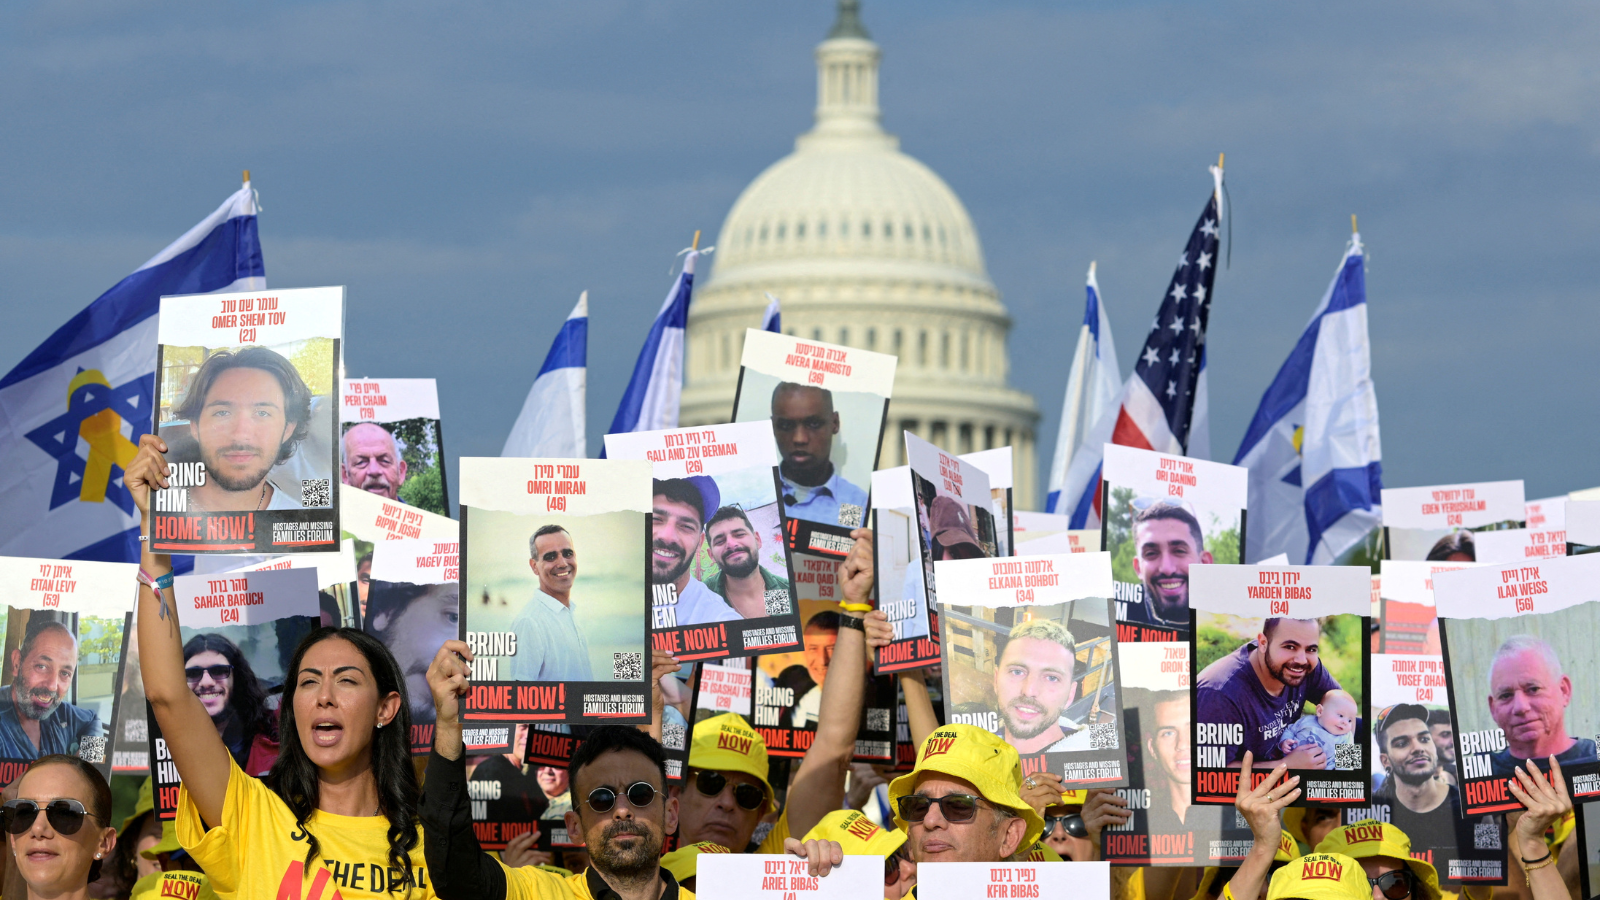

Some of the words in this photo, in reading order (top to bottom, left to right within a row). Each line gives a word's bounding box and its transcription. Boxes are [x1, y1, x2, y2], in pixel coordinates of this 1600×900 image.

[220, 300, 236, 314] טוב
[239, 299, 254, 312] שם
[256, 297, 278, 311] עומר
[212, 315, 237, 329] OMER
[240, 312, 265, 327] SHEM
[267, 311, 286, 326] TOV
[239, 327, 256, 343] (21)
[785, 354, 810, 369] AVERA
[812, 359, 852, 377] MANGISTO
[808, 370, 825, 385] (36)
[349, 382, 362, 394] פרי
[363, 382, 380, 394] חיים
[345, 395, 362, 406] PERI
[363, 395, 387, 406] CHAIM
[360, 407, 375, 419] (79)
[664, 433, 684, 448] ברמן
[703, 430, 716, 443] גלי
[647, 449, 666, 462] GALI
[668, 448, 685, 461] AND
[687, 447, 700, 460] ZIV
[702, 443, 738, 458] BERMAN
[556, 464, 580, 479] עמרי
[686, 459, 703, 474] (26)
[1160, 457, 1177, 471] דנינו
[1178, 462, 1194, 474] אורי
[534, 464, 554, 480] מירן
[1156, 470, 1169, 482] ORI
[1170, 472, 1197, 487] DANINO
[527, 481, 552, 495] OMRI
[554, 481, 586, 495] MIRAN
[1168, 483, 1184, 498] (24)
[155, 488, 187, 512] HIM
[546, 496, 566, 512] (46)
[1422, 503, 1440, 515] EDEN
[1441, 500, 1486, 514] YERUSHALMI
[402, 510, 423, 527] ביפין
[155, 515, 202, 541] HOME
[207, 512, 255, 541] NOW!
[273, 522, 299, 532] HOSTAGES
[299, 522, 310, 531] AND
[310, 521, 333, 530] MISSING
[375, 515, 398, 532] BIPIN
[399, 518, 422, 539] JOSHI
[273, 531, 304, 542] FAMILIES
[306, 529, 333, 542] FORUM
[1525, 545, 1550, 558] DANIEL
[416, 556, 441, 569] YAGEV
[993, 562, 1022, 576] בוחבוט
[1025, 560, 1054, 573] אלקנה
[39, 564, 51, 577] לוי
[53, 565, 72, 579] איתן
[1501, 569, 1519, 583] וייס
[1520, 566, 1540, 582] אילן
[31, 579, 55, 592] EITAN
[55, 580, 77, 593] LEVY
[229, 578, 248, 593] סהר
[816, 573, 834, 586] QAID
[989, 576, 1023, 590] ELKANA
[1025, 574, 1059, 588] BOHBOT
[1259, 572, 1280, 585] ביבס
[1282, 572, 1300, 586] ירדן
[208, 580, 227, 595] ברוך
[819, 585, 835, 598] (53)
[1247, 586, 1282, 599] YARDEN
[1284, 586, 1312, 600] BIBAS
[1497, 584, 1518, 599] ILAN
[1519, 580, 1548, 596] WEISS
[43, 592, 60, 607] (53)
[194, 596, 225, 609] SAHAR
[228, 592, 264, 607] BARUCH
[1016, 589, 1034, 604] (34)
[1270, 600, 1289, 616] (34)
[1515, 596, 1534, 613] (56)
[220, 608, 240, 623] (24)
[683, 623, 728, 652] NOW!
[742, 628, 765, 638] HOSTAGES
[774, 625, 796, 634] MISSING
[466, 632, 516, 656] BRING
[743, 635, 773, 648] FAMILIES
[773, 632, 798, 645] FORUM
[880, 641, 915, 665] HOME
[1163, 647, 1186, 660] שאול
[466, 658, 498, 681] HIM
[1161, 661, 1185, 673] ORON
[1392, 660, 1416, 673] אוחנה
[1419, 661, 1436, 673] חיים
[1397, 674, 1422, 687] YOSEF
[465, 686, 512, 711] HOME
[517, 683, 565, 711] NOW!
[710, 682, 740, 698] (SASHA)
[757, 687, 794, 708] BRING
[1416, 688, 1433, 702] (24)
[583, 695, 609, 704] HOSTAGES
[610, 695, 621, 703] AND
[621, 694, 644, 703] MISSING
[716, 696, 732, 710] (28)
[583, 703, 616, 714] FAMILIES
[618, 703, 644, 714] FORUM
[755, 705, 780, 727] HIM
[488, 727, 509, 735] MISSING
[721, 724, 733, 733] SEAL
[733, 726, 742, 736] THE
[742, 729, 754, 739] DEAL
[755, 728, 790, 749] HOME
[1196, 722, 1243, 746] BRING
[485, 734, 509, 745] FORUM
[531, 733, 573, 759] HOME
[718, 732, 752, 754] NOW
[1460, 728, 1506, 755] BRING
[1197, 746, 1226, 768] HIM
[1064, 761, 1089, 771] HOSTAGES
[1089, 761, 1098, 769] AND
[1099, 760, 1120, 769] MISSING
[1462, 754, 1493, 780] HIM
[1064, 769, 1096, 781] FAMILIES
[1097, 767, 1121, 779] FORUM
[1572, 773, 1597, 784] HOSTAGES
[1197, 771, 1240, 794] HOME
[1306, 780, 1331, 790] HOSTAGES
[1332, 781, 1342, 790] AND
[1342, 781, 1365, 790] MISSING
[1307, 788, 1338, 799] FAMILIES
[1339, 789, 1365, 800] FORUM
[1465, 778, 1510, 806] HOME
[1347, 804, 1391, 825] BRING
[848, 815, 878, 840] NOW
[1344, 825, 1384, 844] NOW
[1107, 834, 1147, 855] HOME
[1151, 831, 1194, 855] NOW!
[1210, 840, 1233, 848] HOSTAGES
[1210, 847, 1239, 857] FAMILIES
[765, 860, 786, 875] ביבס
[1302, 861, 1343, 879] NOW
[1449, 859, 1472, 868] HOSTAGES
[1472, 860, 1481, 868] AND
[1481, 860, 1502, 868] MISSING
[164, 873, 178, 881] SEAL
[178, 874, 189, 882] THE
[189, 875, 203, 885] DEAL
[989, 868, 1012, 883] ביבס
[1014, 868, 1036, 883] כפיר
[1449, 867, 1477, 877] FAMILIES
[1479, 867, 1502, 878] FORUM
[161, 879, 201, 900] NOW
[761, 877, 788, 891] ARIEL
[790, 877, 819, 891] BIBAS
[987, 884, 1008, 899] KFIR
[1010, 884, 1040, 899] BIBAS
